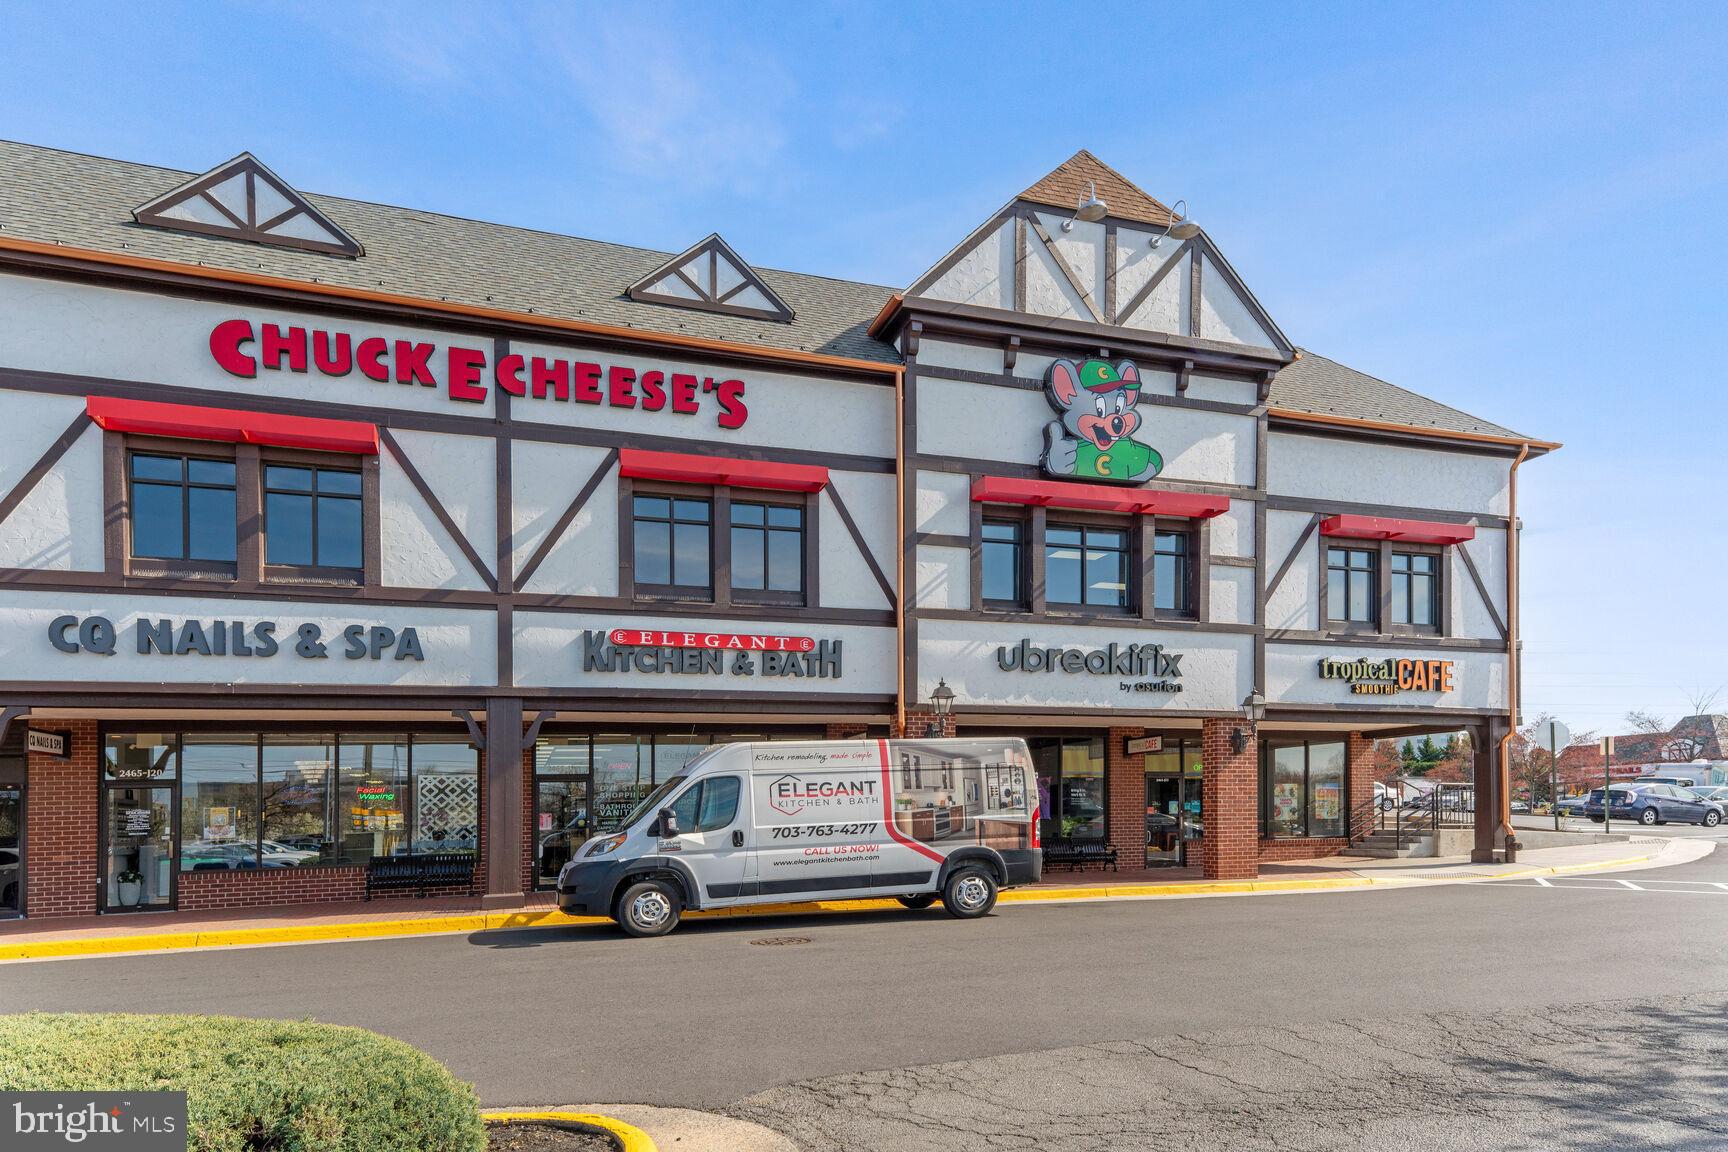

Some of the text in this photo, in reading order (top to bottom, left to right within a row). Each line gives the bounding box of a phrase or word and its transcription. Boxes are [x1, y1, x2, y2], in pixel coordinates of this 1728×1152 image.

[209, 319, 748, 431] CHUCK E CHEESE'S
[48, 615, 424, 661] CQ NAILS & SPA
[640, 631, 790, 650] ELEGANT
[583, 630, 843, 678] KITCHEN & BATH
[997, 638, 1184, 677] ubreakifix
[1319, 657, 1454, 692] tropical CAFE
[1119, 680, 1183, 693] by asurion
[1353, 683, 1399, 695] SMOOTHIE
[36, 736, 49, 748] NAILS
[54, 738, 62, 750] SPA
[852, 752, 872, 761] simple
[778, 780, 877, 798] ELEGANT
[779, 799, 830, 808] KITCHEN
[849, 797, 879, 805] BATH
[772, 823, 878, 839] 703-763-4277
[804, 844, 880, 856] CALL US NOW!
[773, 854, 880, 867] www.elegantkitchenbath.com
